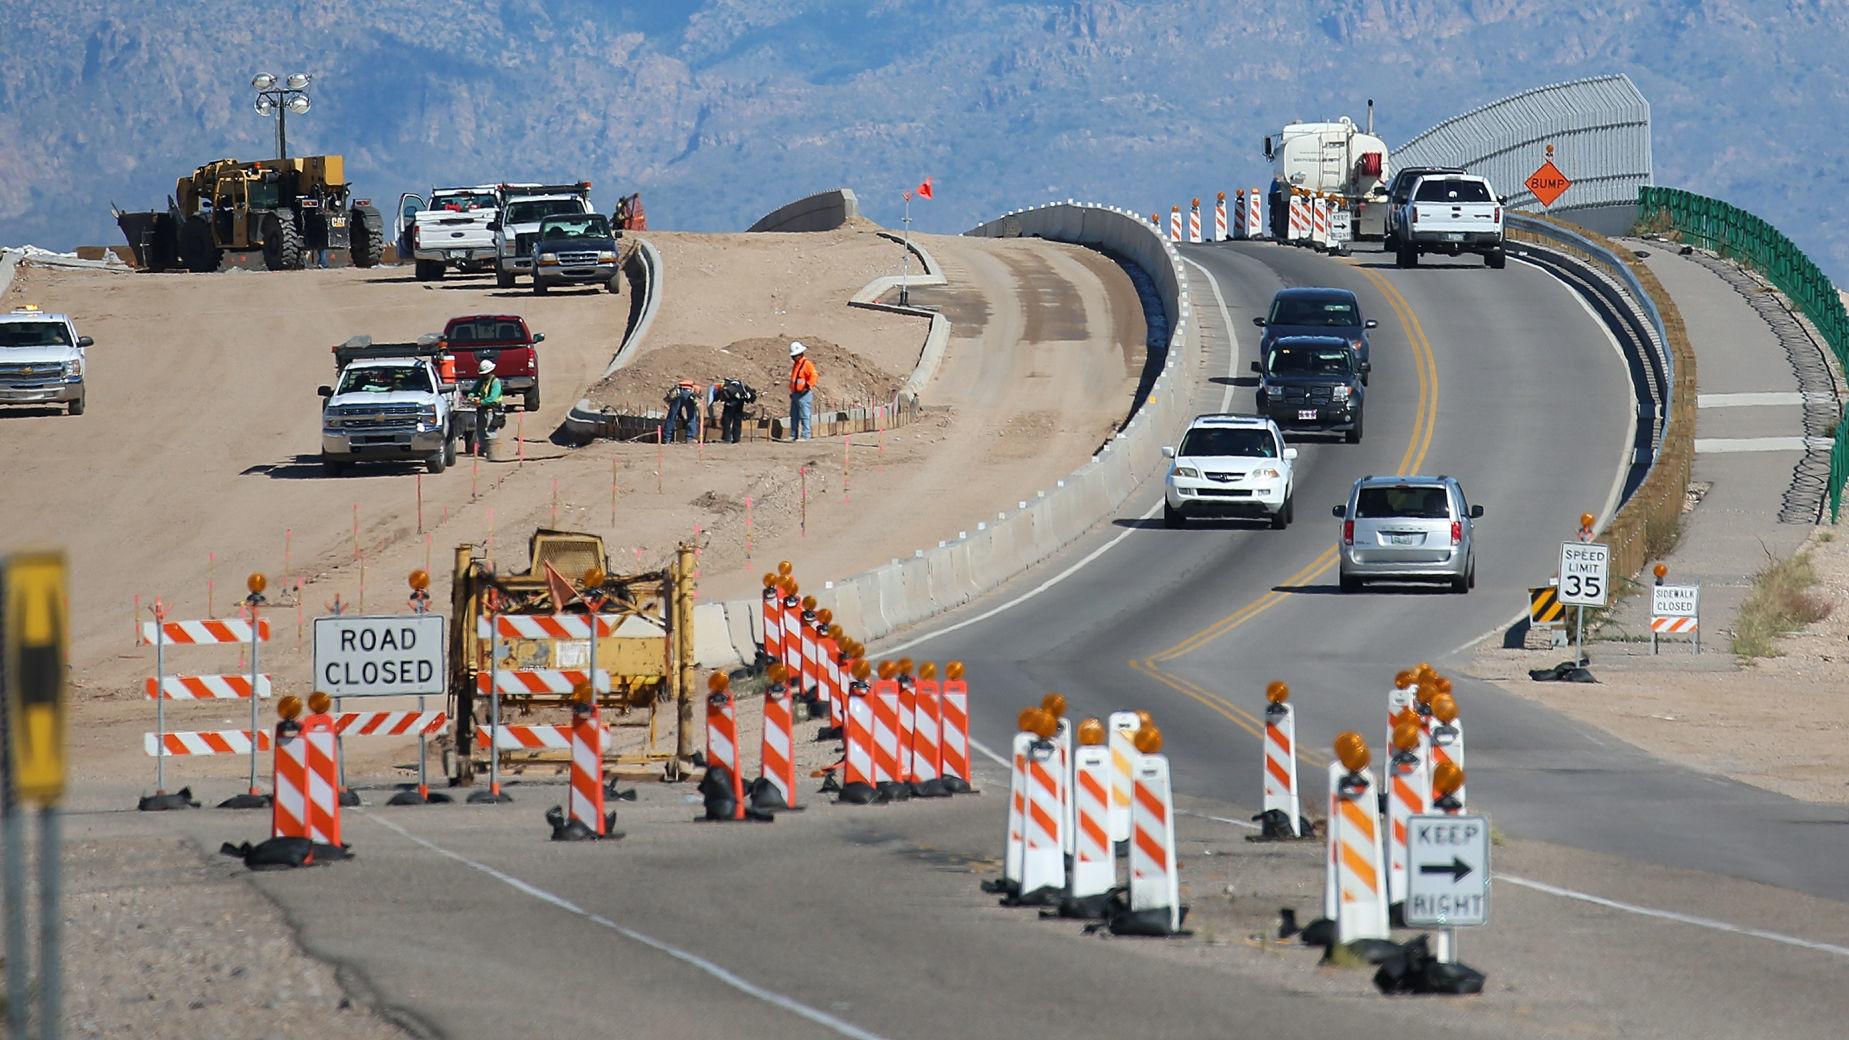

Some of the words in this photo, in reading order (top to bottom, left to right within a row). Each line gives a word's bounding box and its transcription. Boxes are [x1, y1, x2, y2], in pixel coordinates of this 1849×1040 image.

[1531, 178, 1565, 189] BUMP
[331, 217, 346, 228] CAT
[1565, 549, 1605, 562] SPEED
[1569, 562, 1599, 575] LIMIT
[1565, 575, 1601, 597] 35
[1656, 588, 1694, 600] SIDEWALK
[1657, 601, 1692, 612] CLOSED
[341, 628, 416, 652] ROAD
[325, 659, 433, 685] CLOSED
[1418, 825, 1479, 845] KEEP
[1414, 894, 1483, 916] RIGHT
